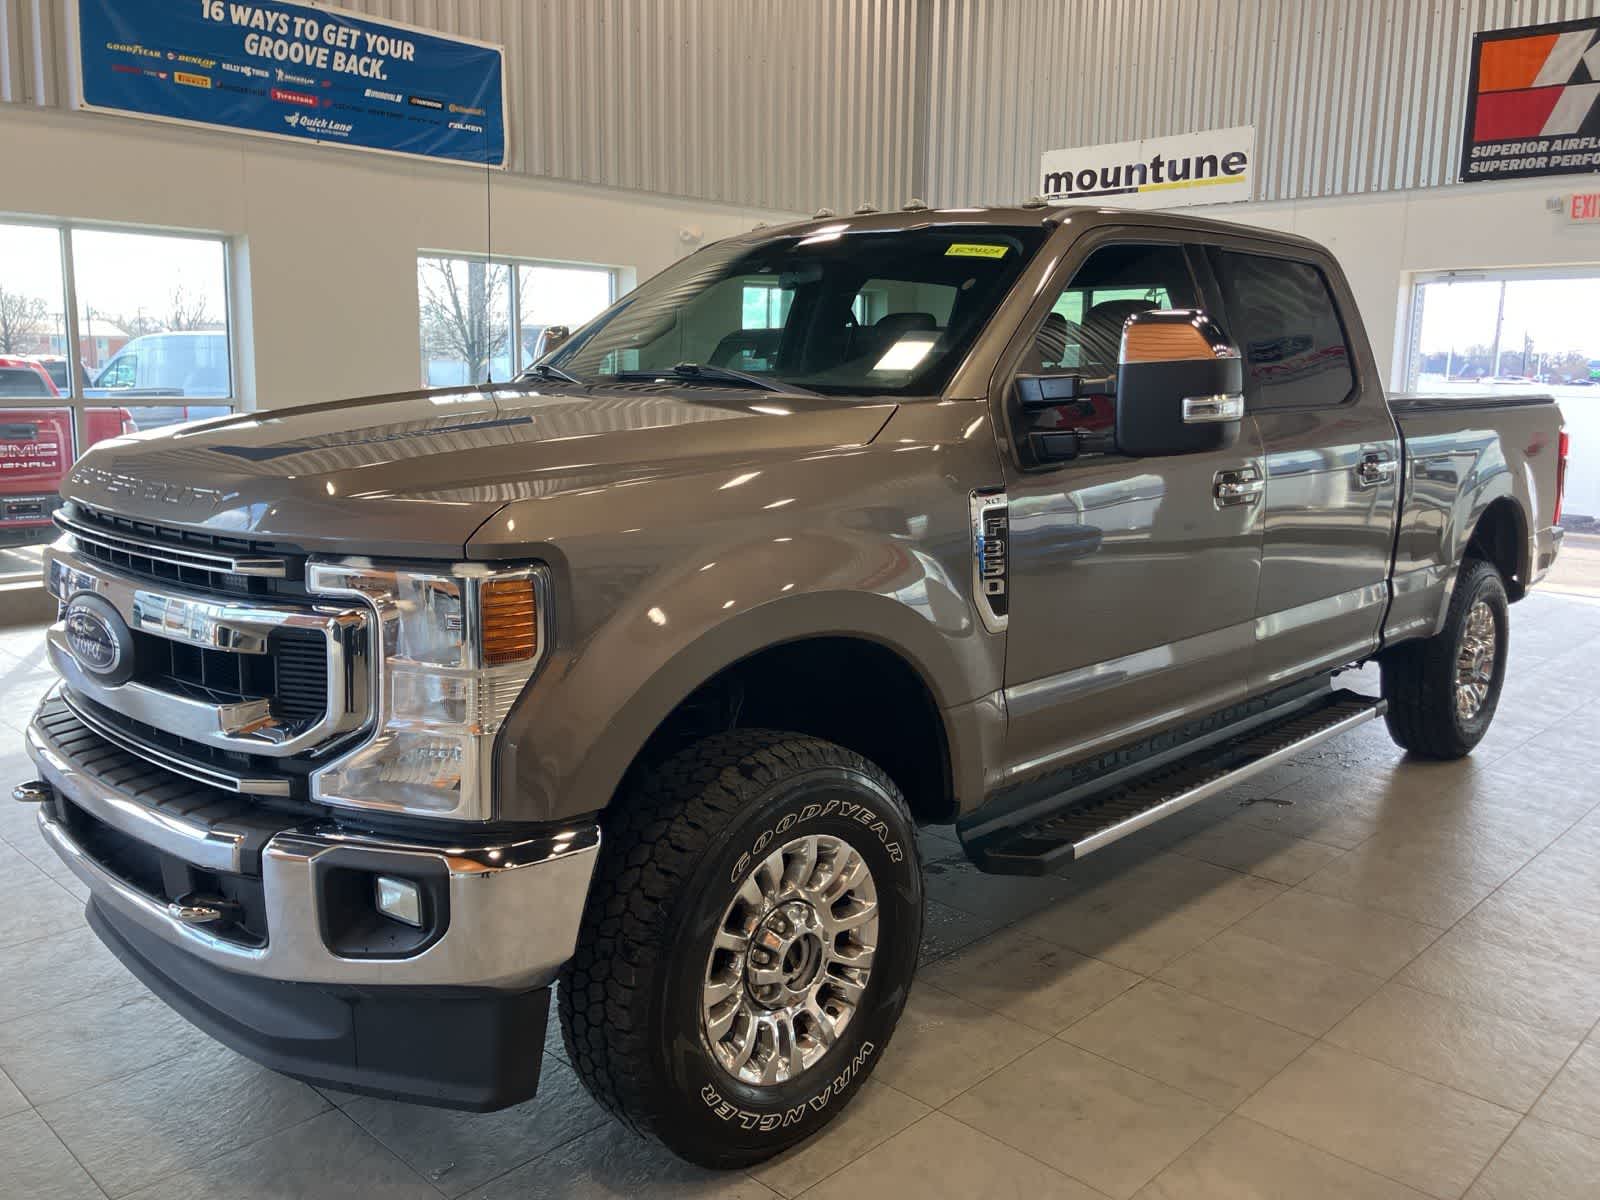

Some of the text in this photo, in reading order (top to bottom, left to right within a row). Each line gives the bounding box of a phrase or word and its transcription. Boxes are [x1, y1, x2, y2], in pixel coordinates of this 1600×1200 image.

[202, 0, 415, 62] 16 WAYS TO GET YOUR
[106, 42, 161, 58] GOODYEAR
[178, 54, 217, 68] DUNLOP
[244, 33, 388, 80] GROOVE BACK.
[299, 115, 353, 132] Quick Lane
[1471, 136, 1600, 158] SUPERIOR AIRFL
[1043, 151, 1248, 195] mountune
[1469, 157, 1547, 173] SUPERIOR
[1571, 194, 1600, 219] EXI
[0, 461, 56, 469] ENALI
[985, 497, 1001, 505] XLT
[731, 800, 903, 883] GOODYEAR
[701, 1041, 875, 1131] WRANGLER
